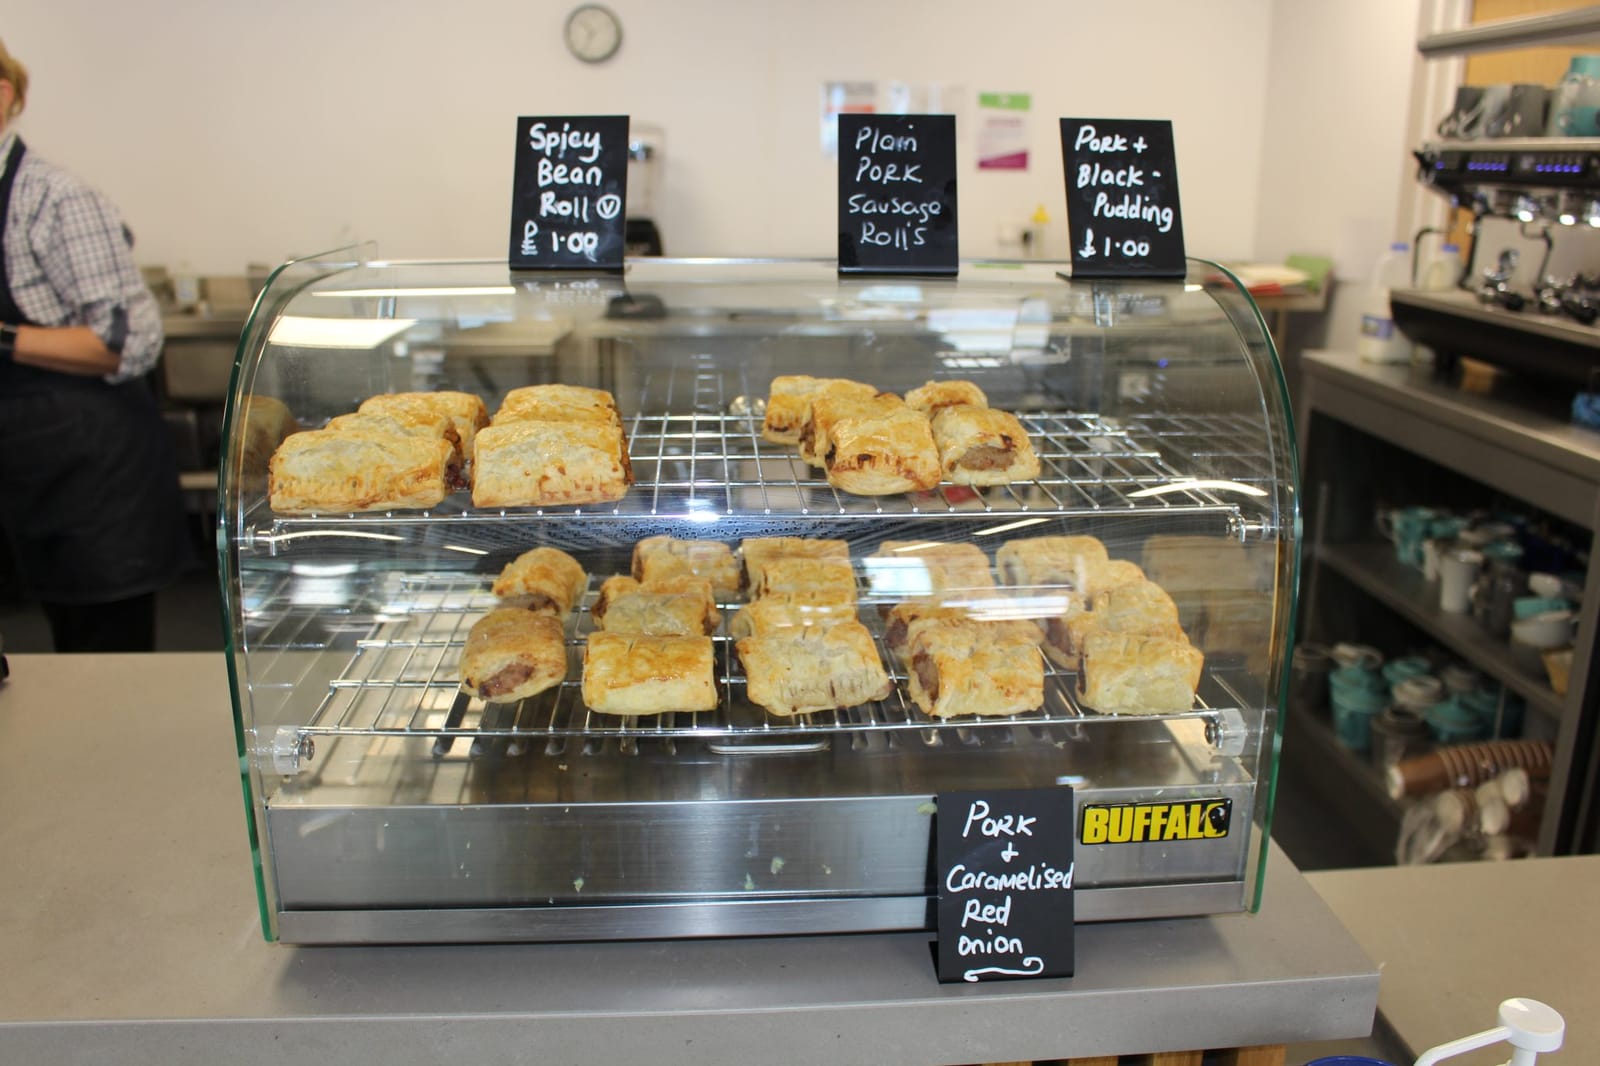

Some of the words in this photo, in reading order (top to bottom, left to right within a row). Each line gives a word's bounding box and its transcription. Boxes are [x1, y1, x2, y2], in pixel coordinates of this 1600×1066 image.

[529, 122, 602, 163] Spicy
[855, 124, 918, 154] Plain
[1132, 136, 1148, 154] +
[537, 157, 602, 187] Bean
[1076, 162, 1144, 189] Black
[539, 190, 590, 224] Roll
[848, 193, 942, 223] Sausage
[1093, 191, 1174, 233] Pudding
[961, 895, 1012, 927] Red
